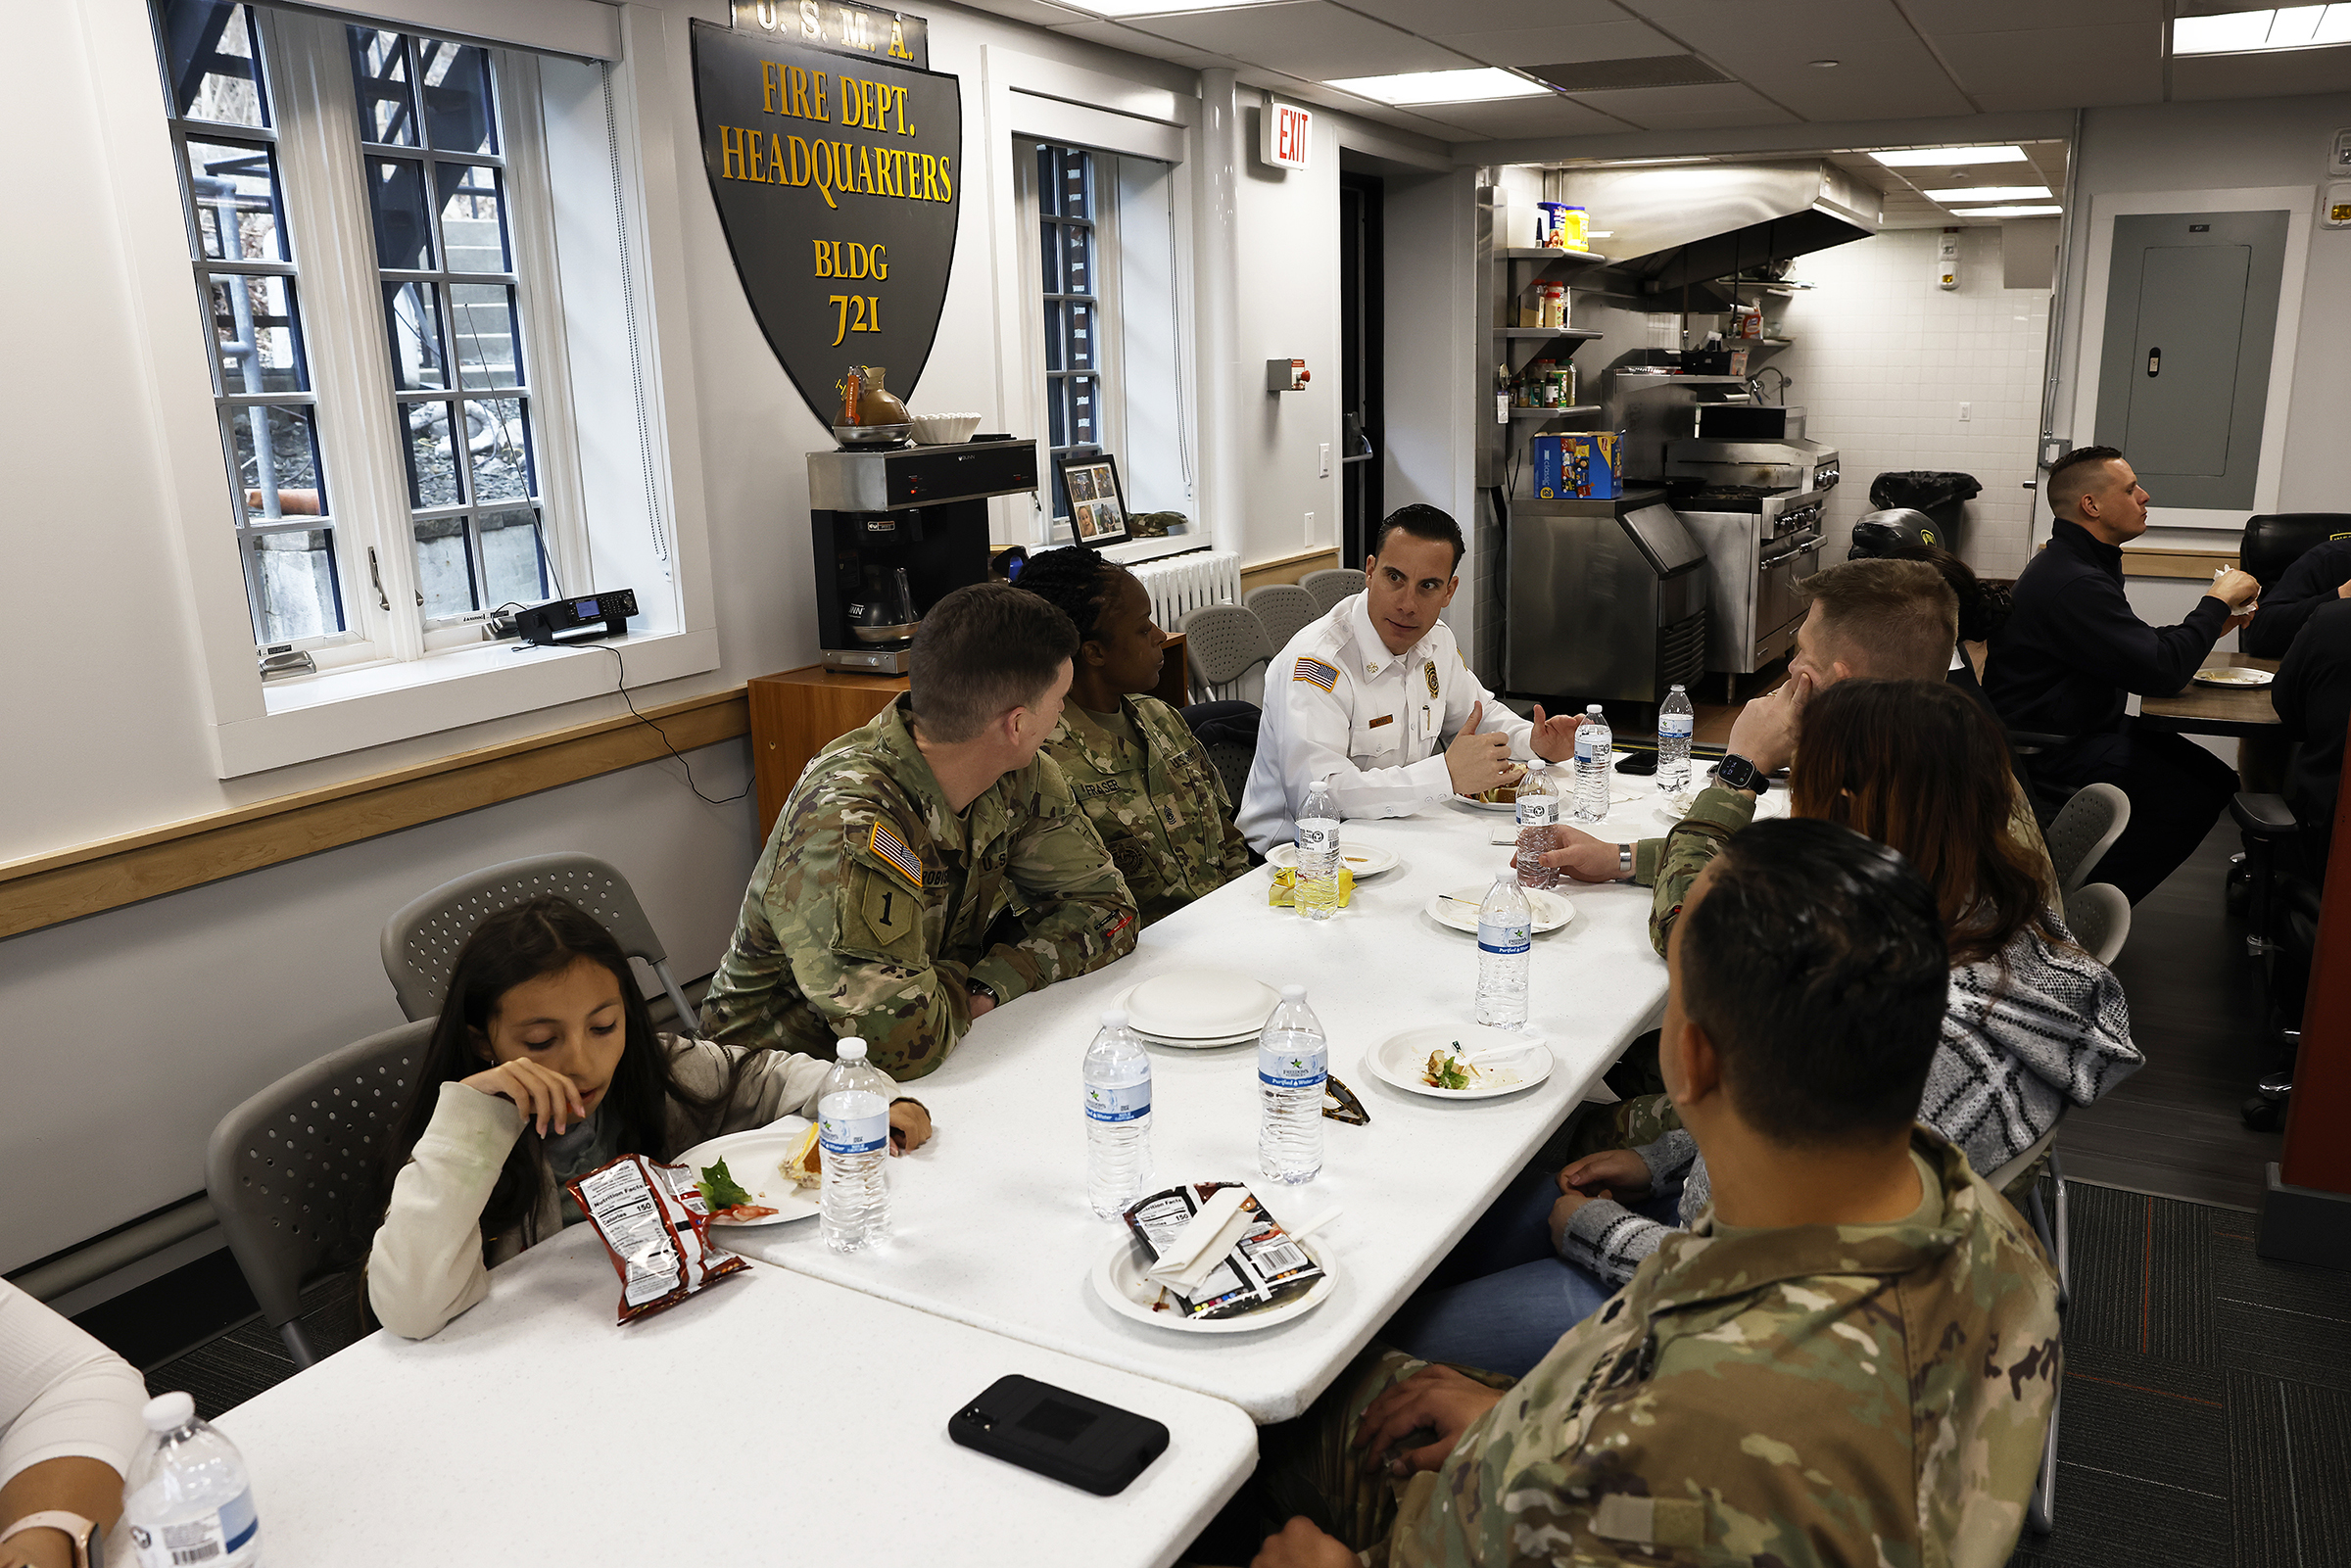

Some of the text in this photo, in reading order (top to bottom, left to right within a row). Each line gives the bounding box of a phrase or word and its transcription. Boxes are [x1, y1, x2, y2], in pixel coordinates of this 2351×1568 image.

[759, 60, 917, 137] FIRE DEPT.
[1278, 108, 1309, 164] EXIT
[718, 125, 953, 209] HEADQUARTERS
[812, 239, 888, 281] BLDG
[829, 294, 882, 347] 721
[1084, 779, 1121, 797] FRASER
[879, 891, 892, 927] 1
[594, 1190, 624, 1208] Nutrition
[624, 1183, 644, 1194] Facts
[637, 1202, 651, 1212] 150
[601, 1212, 627, 1226] Calories
